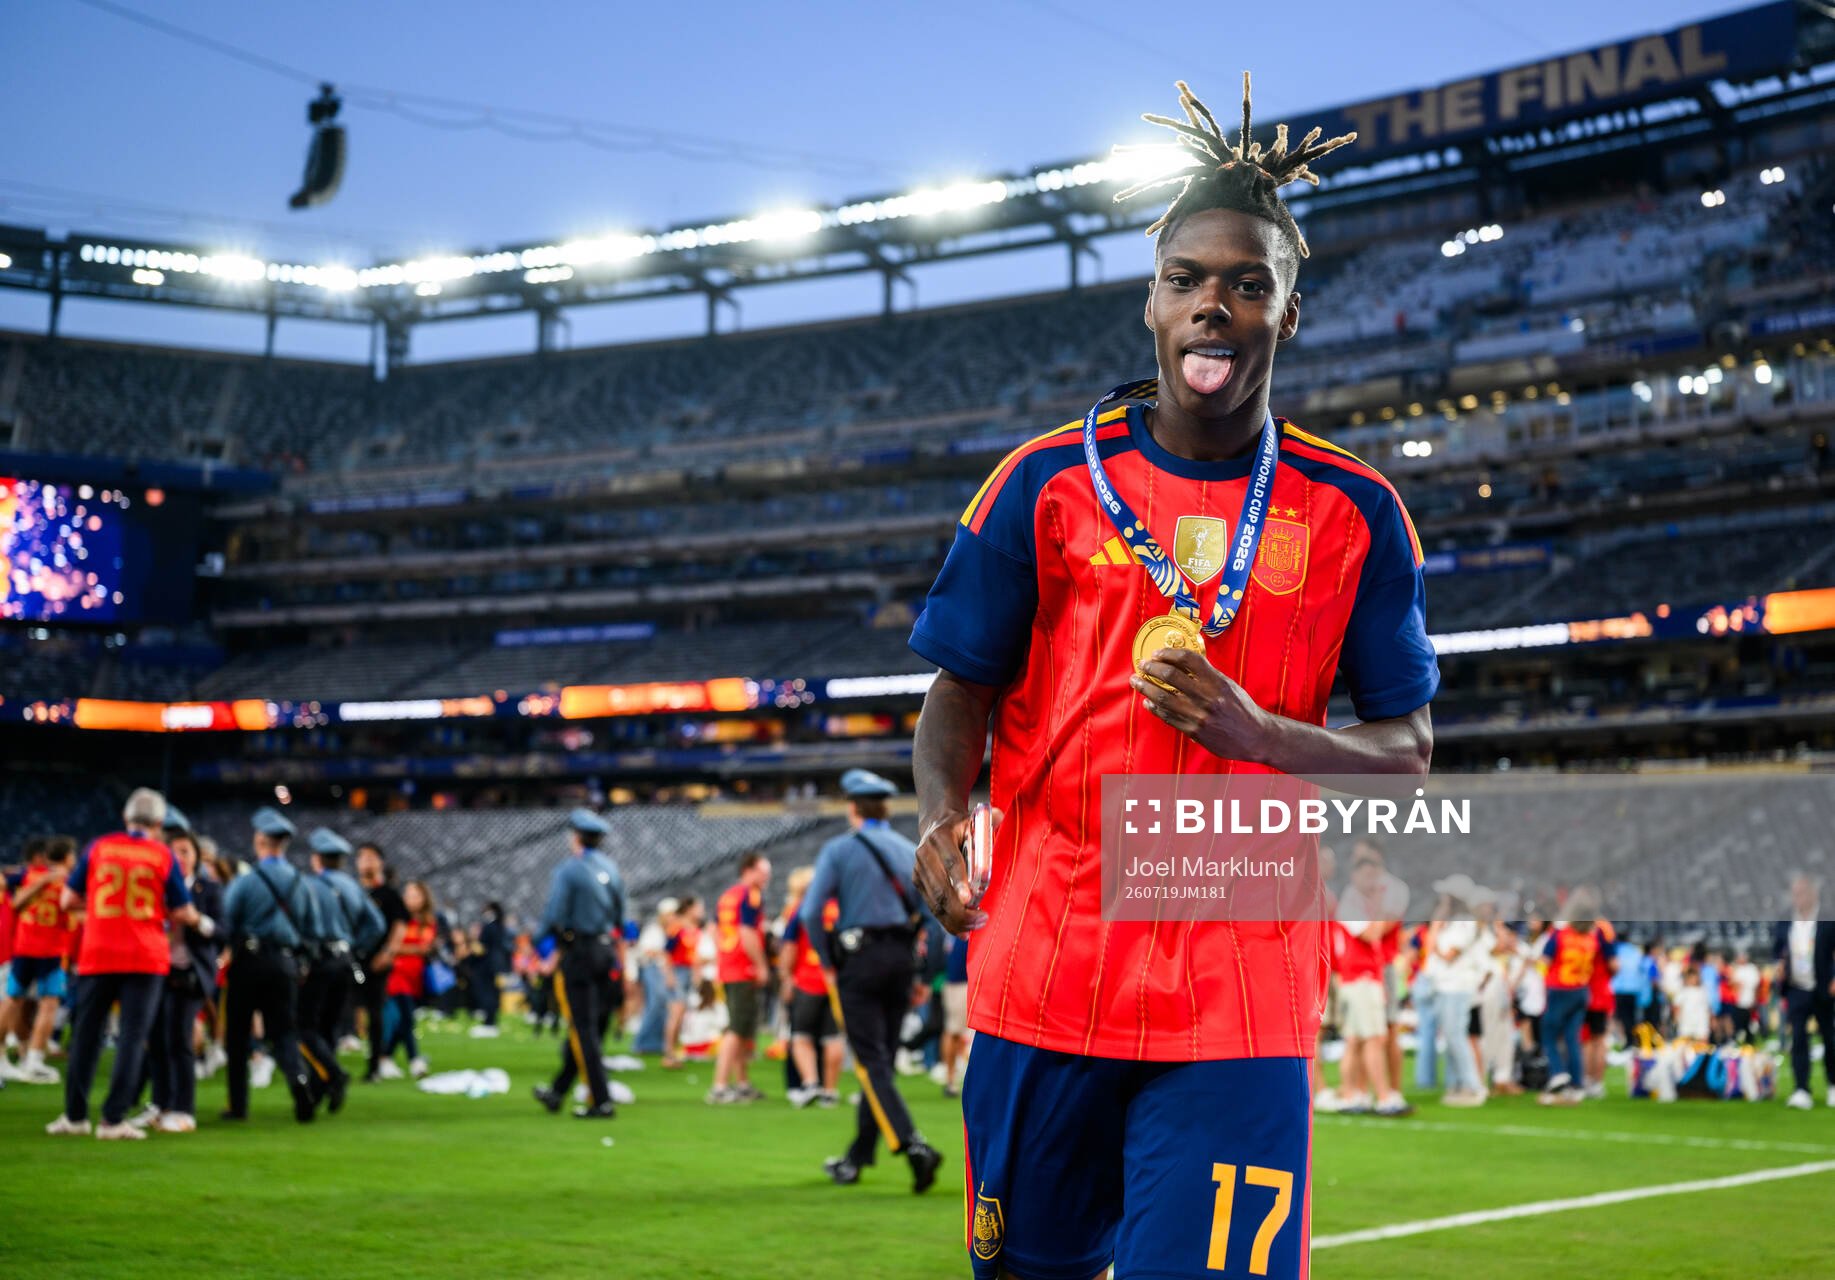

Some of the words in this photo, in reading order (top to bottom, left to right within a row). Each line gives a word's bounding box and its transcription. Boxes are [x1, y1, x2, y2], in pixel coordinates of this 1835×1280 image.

[1343, 77, 1484, 150] THE
[1500, 24, 1727, 119] FINAL
[1263, 430, 1275, 456] FIFA
[1088, 445, 1097, 470] CUP
[1094, 470, 1121, 515] 2026
[1253, 456, 1272, 499] WORLD
[1247, 499, 1262, 524] CUP
[1187, 557, 1211, 568] FIFA
[1232, 523, 1256, 572] 2026
[94, 863, 155, 921] 26
[1207, 1162, 1294, 1276] 17
